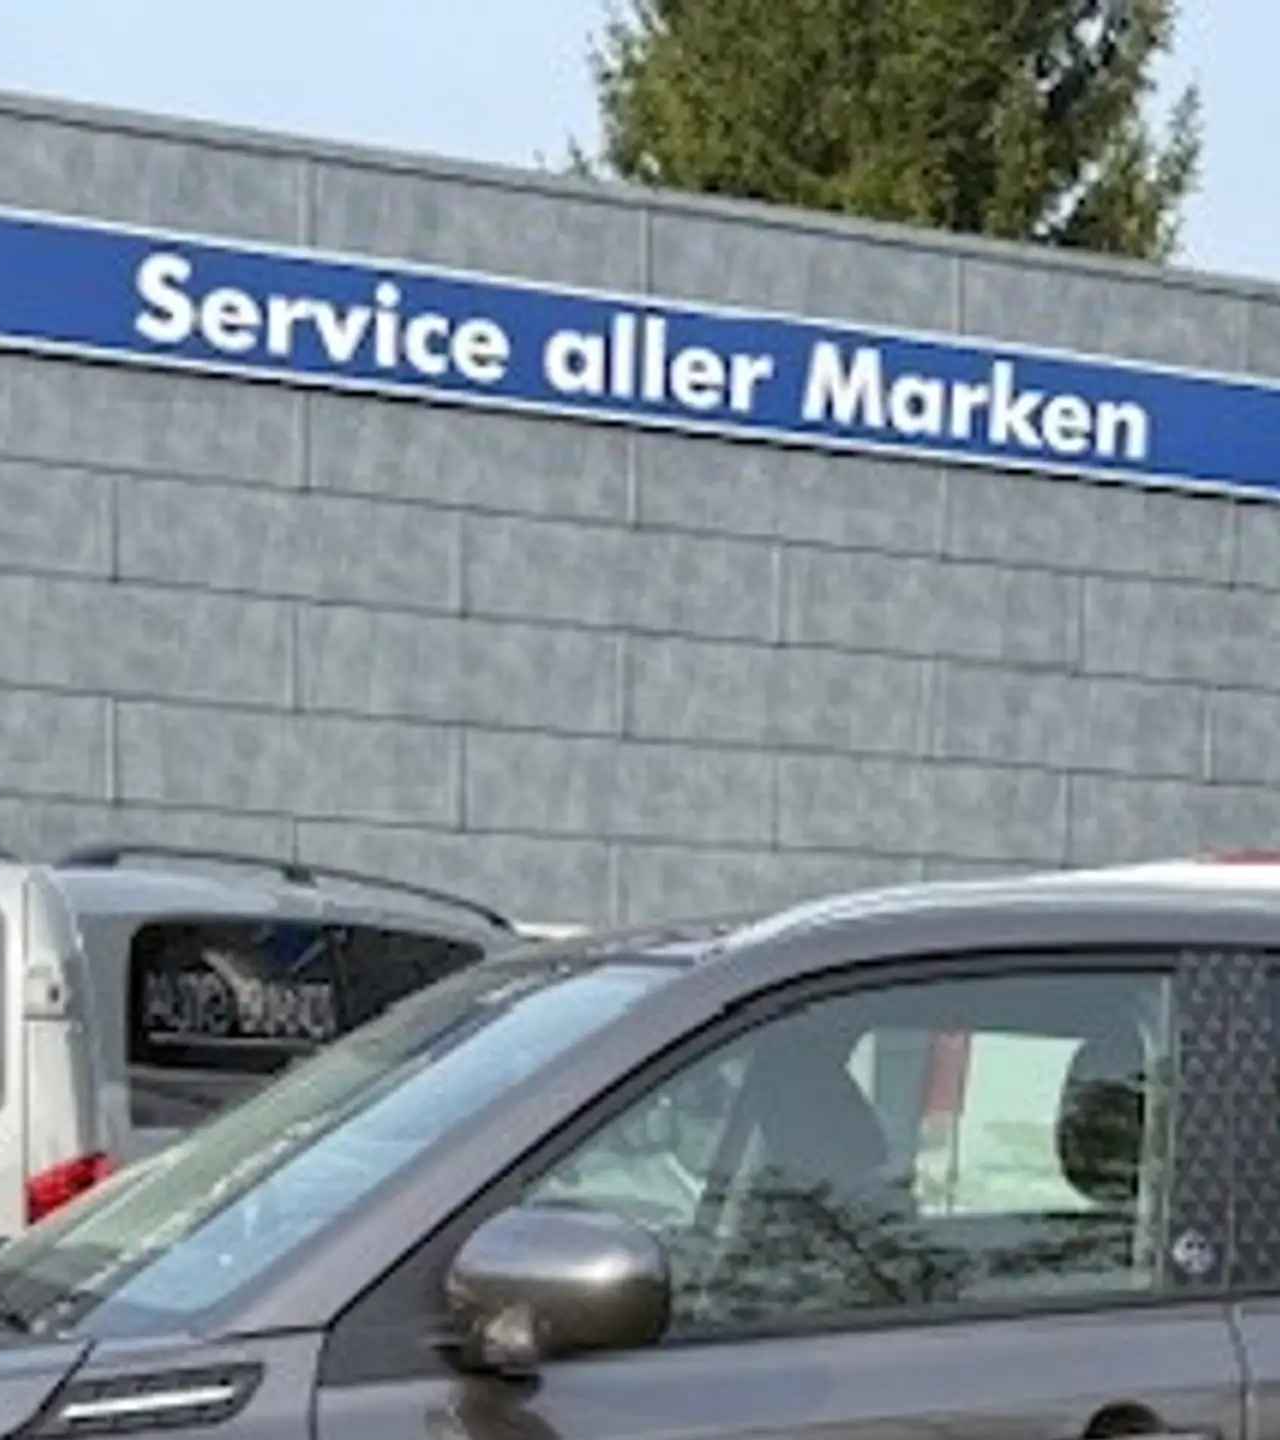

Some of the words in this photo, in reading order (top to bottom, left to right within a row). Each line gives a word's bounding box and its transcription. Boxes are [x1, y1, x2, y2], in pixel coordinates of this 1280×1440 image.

[135, 253, 510, 383] Service
[544, 313, 774, 412] aller
[803, 340, 1148, 459] Marken
